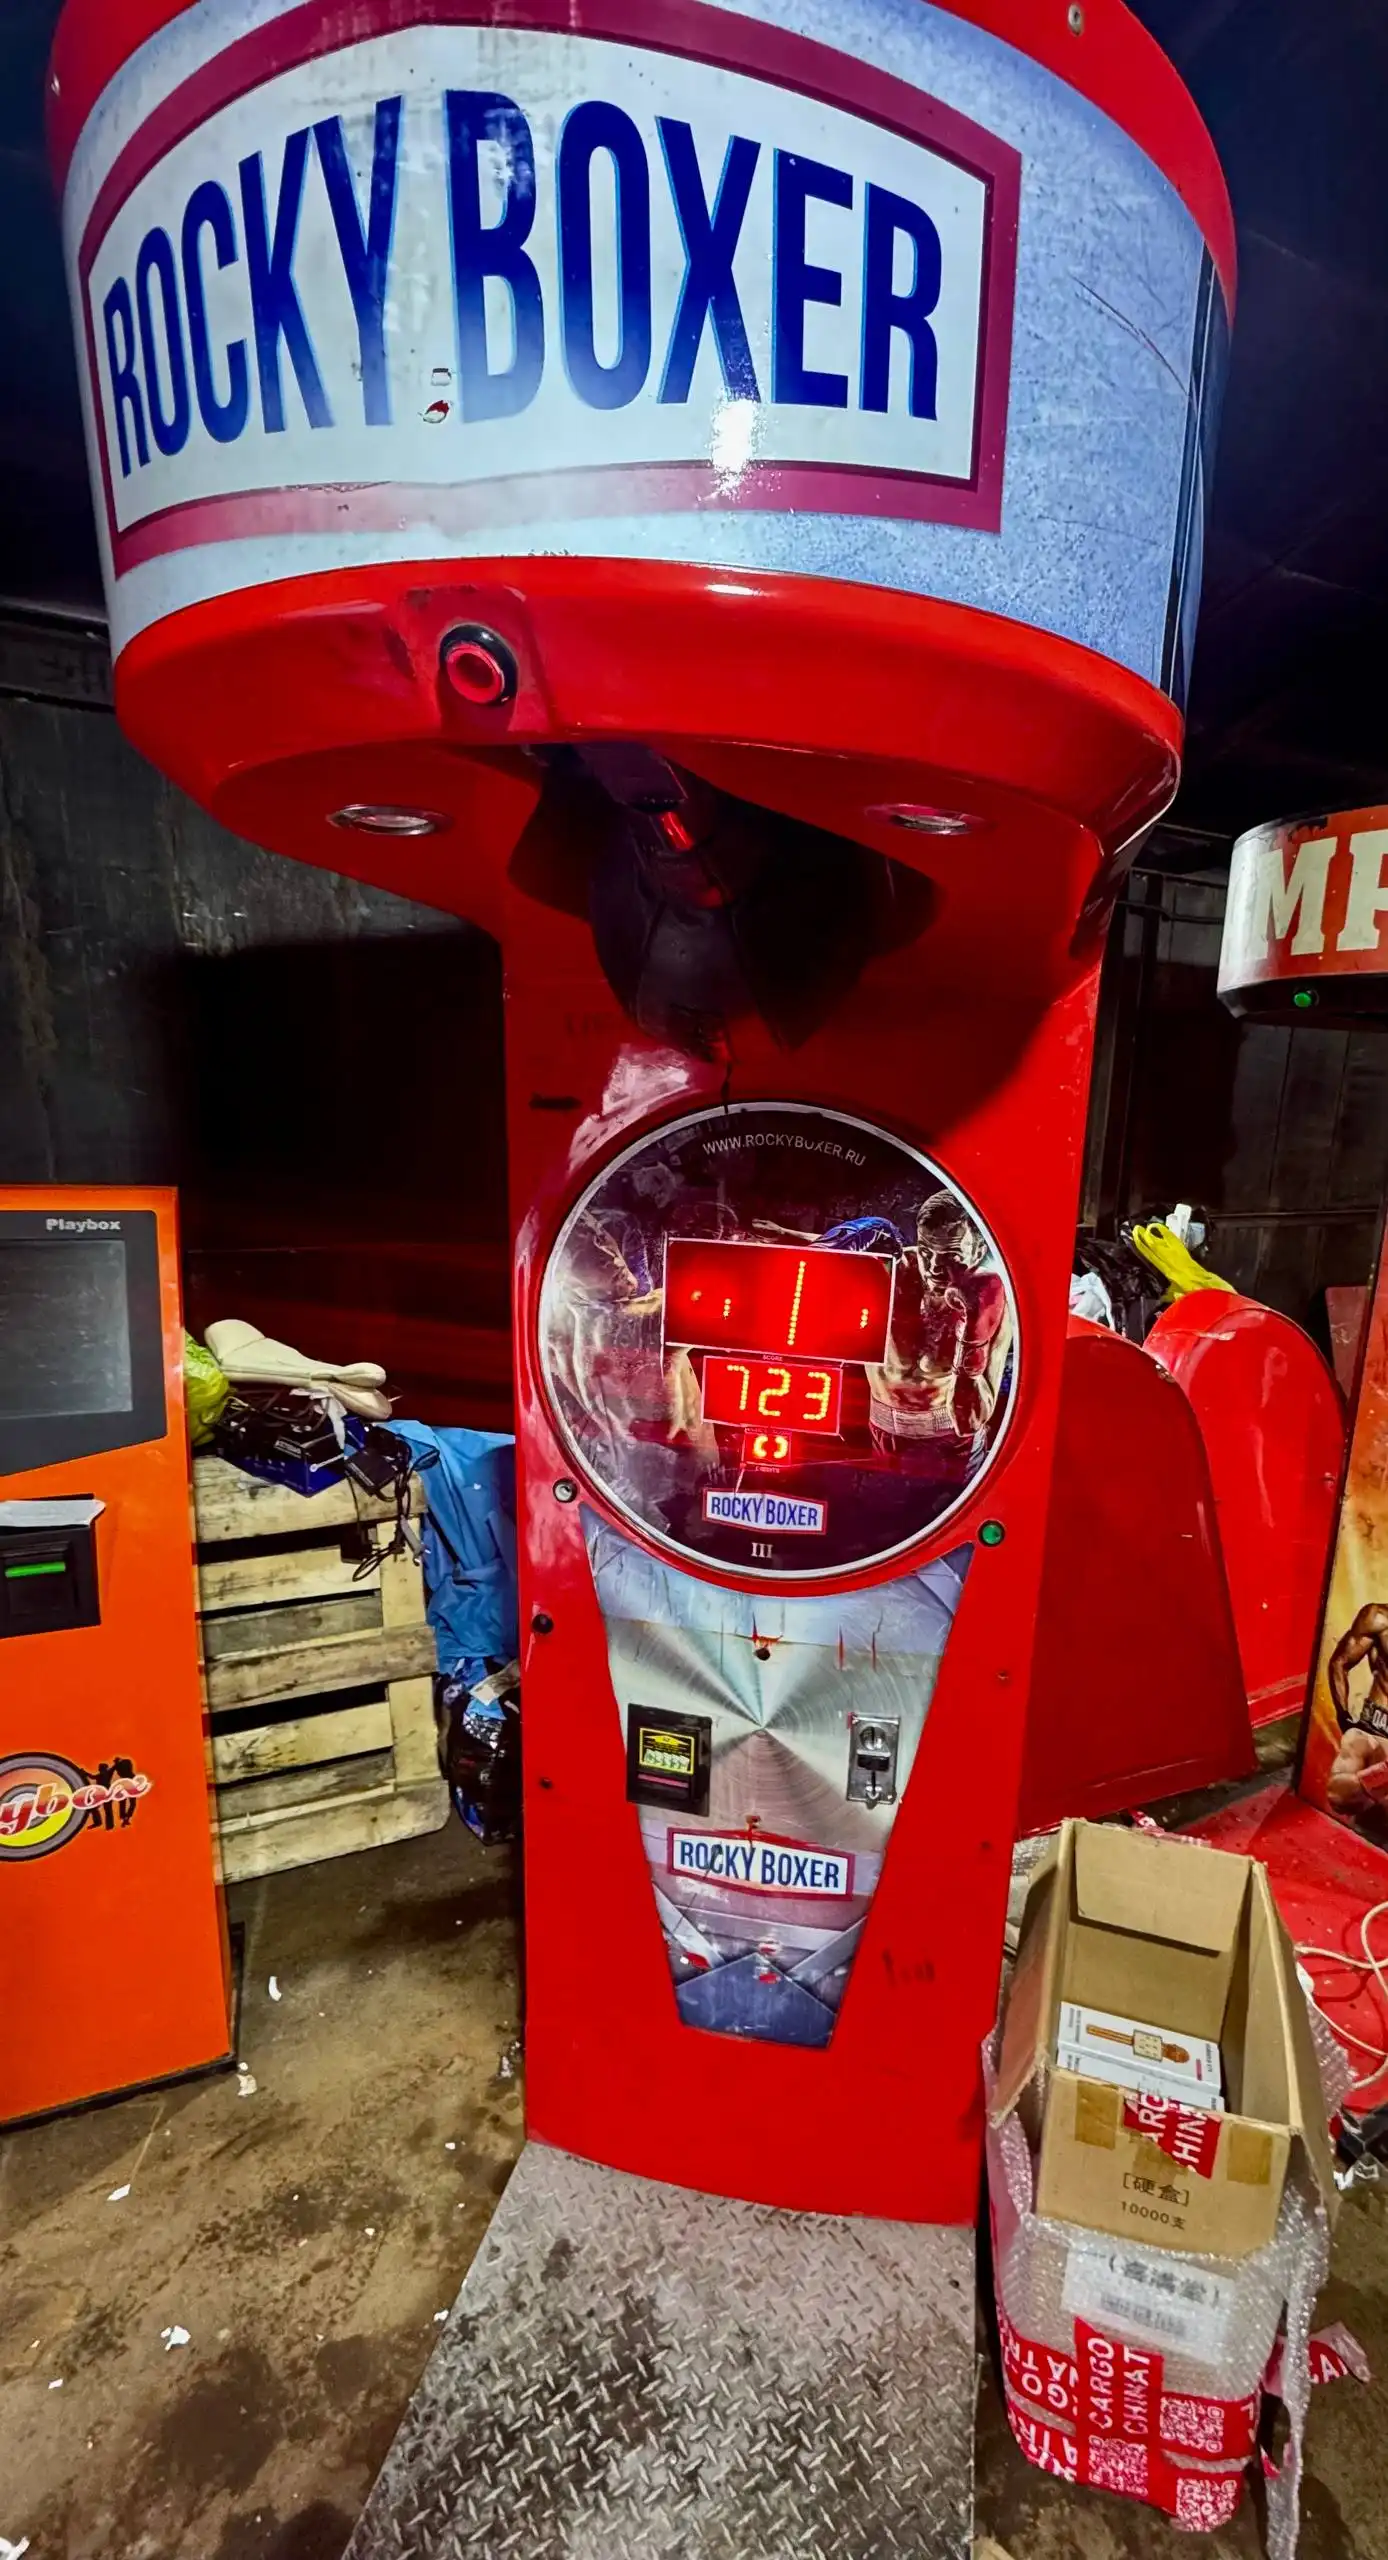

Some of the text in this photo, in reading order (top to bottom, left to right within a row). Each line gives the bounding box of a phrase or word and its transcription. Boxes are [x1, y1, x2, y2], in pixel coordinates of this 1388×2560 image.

[103, 88, 944, 480] ROCKY BOXER
[46, 1218, 121, 1233] Playbox
[726, 1364, 831, 1421] 723
[711, 1496, 818, 1526] ROCKY BOXER
[680, 1841, 839, 1889] ROCKY BOXER
[1087, 2337, 1114, 2430] CARGO
